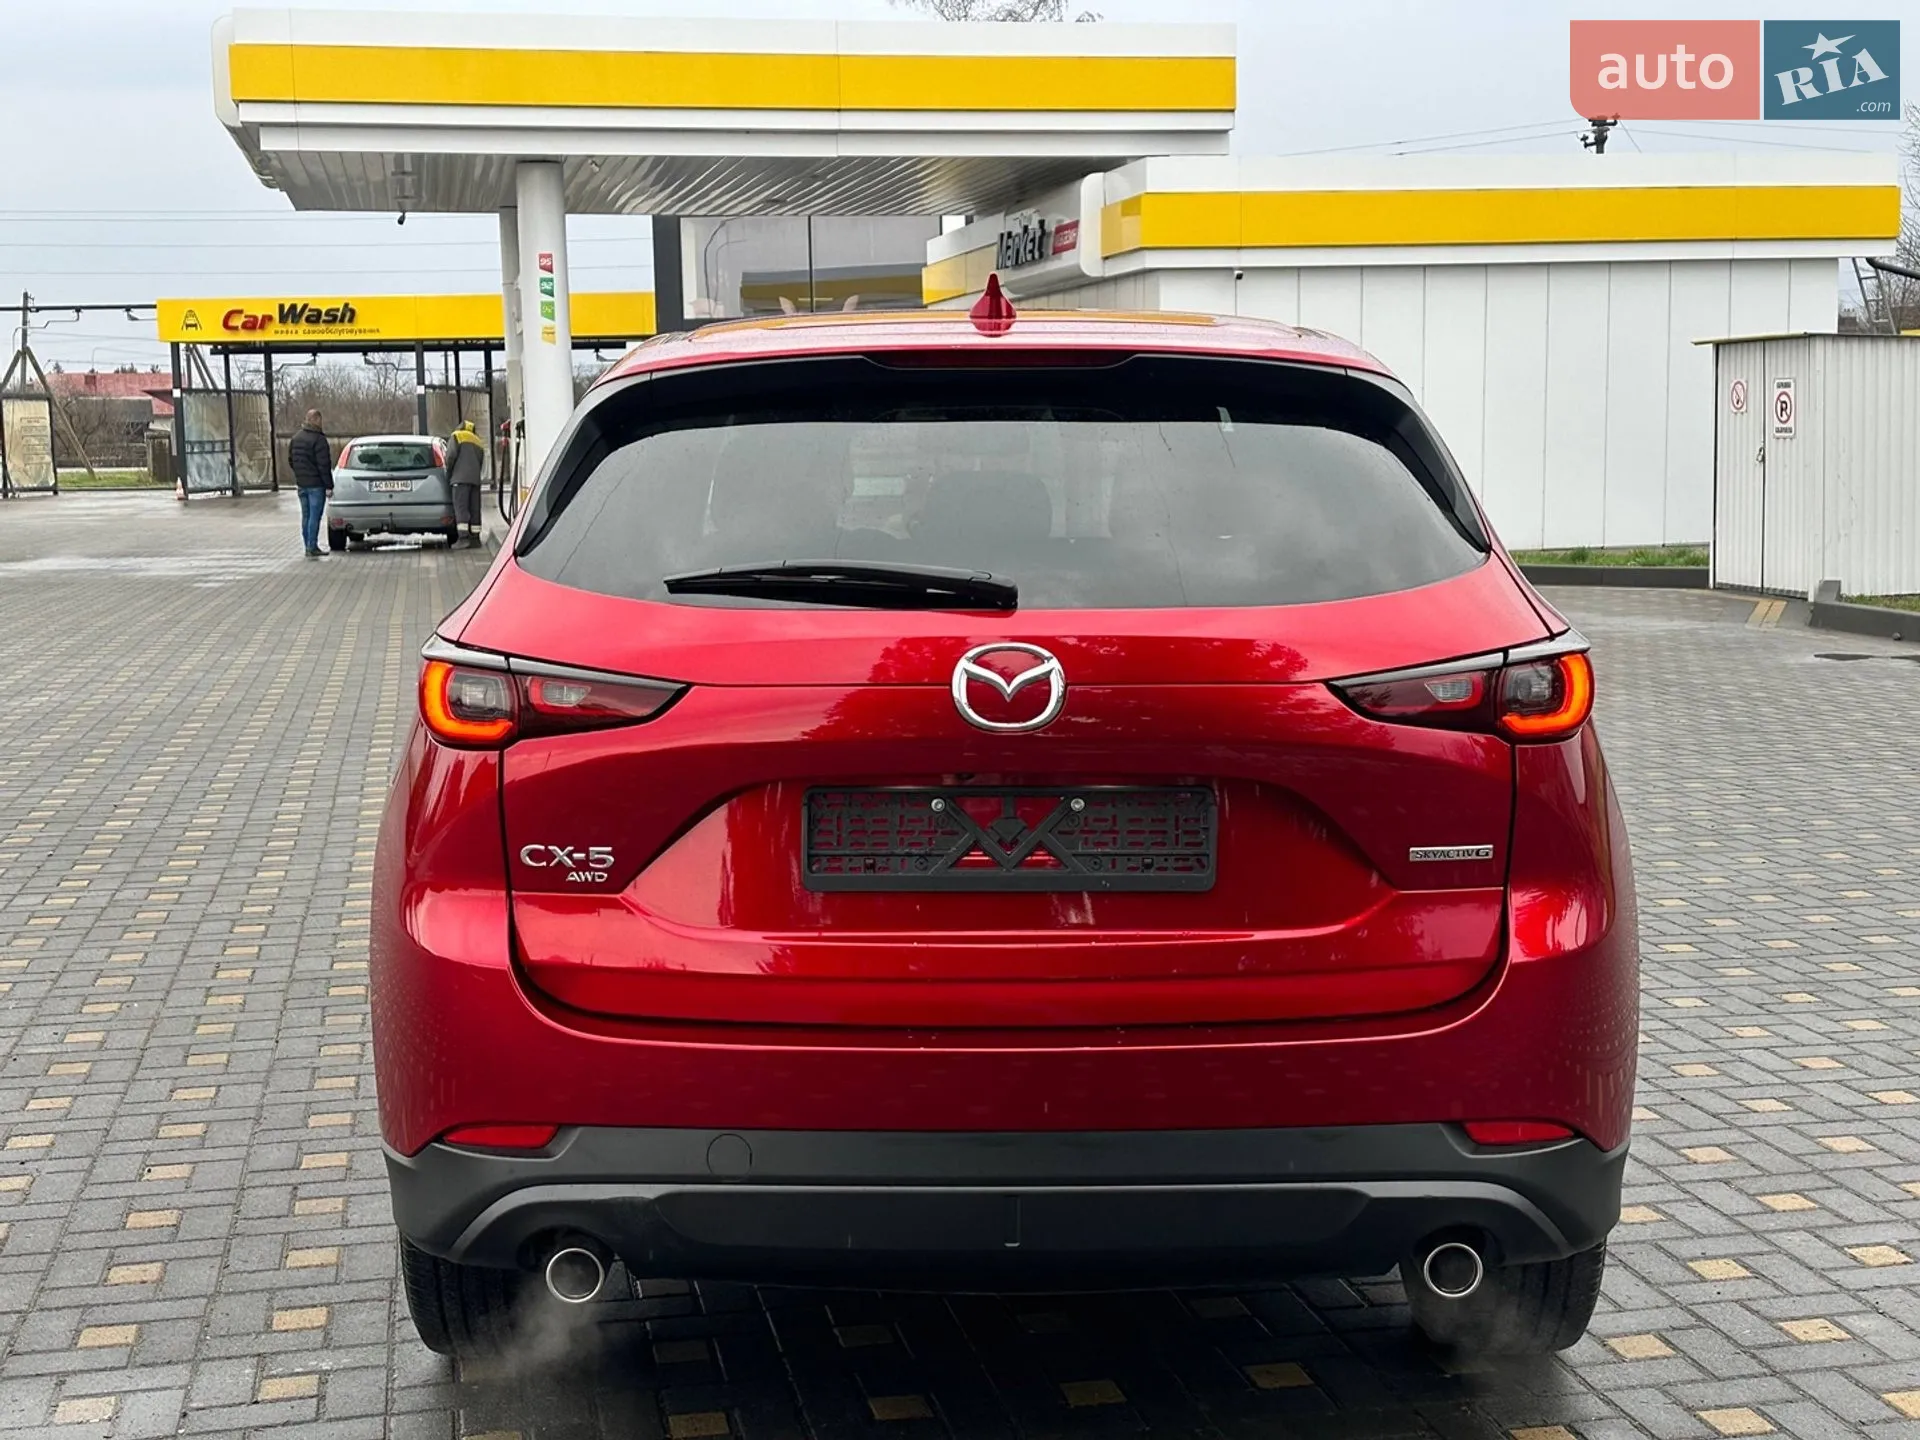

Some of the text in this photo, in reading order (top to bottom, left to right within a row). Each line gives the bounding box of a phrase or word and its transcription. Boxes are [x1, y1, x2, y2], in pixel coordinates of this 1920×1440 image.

[222, 302, 356, 331] Car Wash
[520, 844, 615, 869] CX-5
[565, 871, 608, 882] AWD
